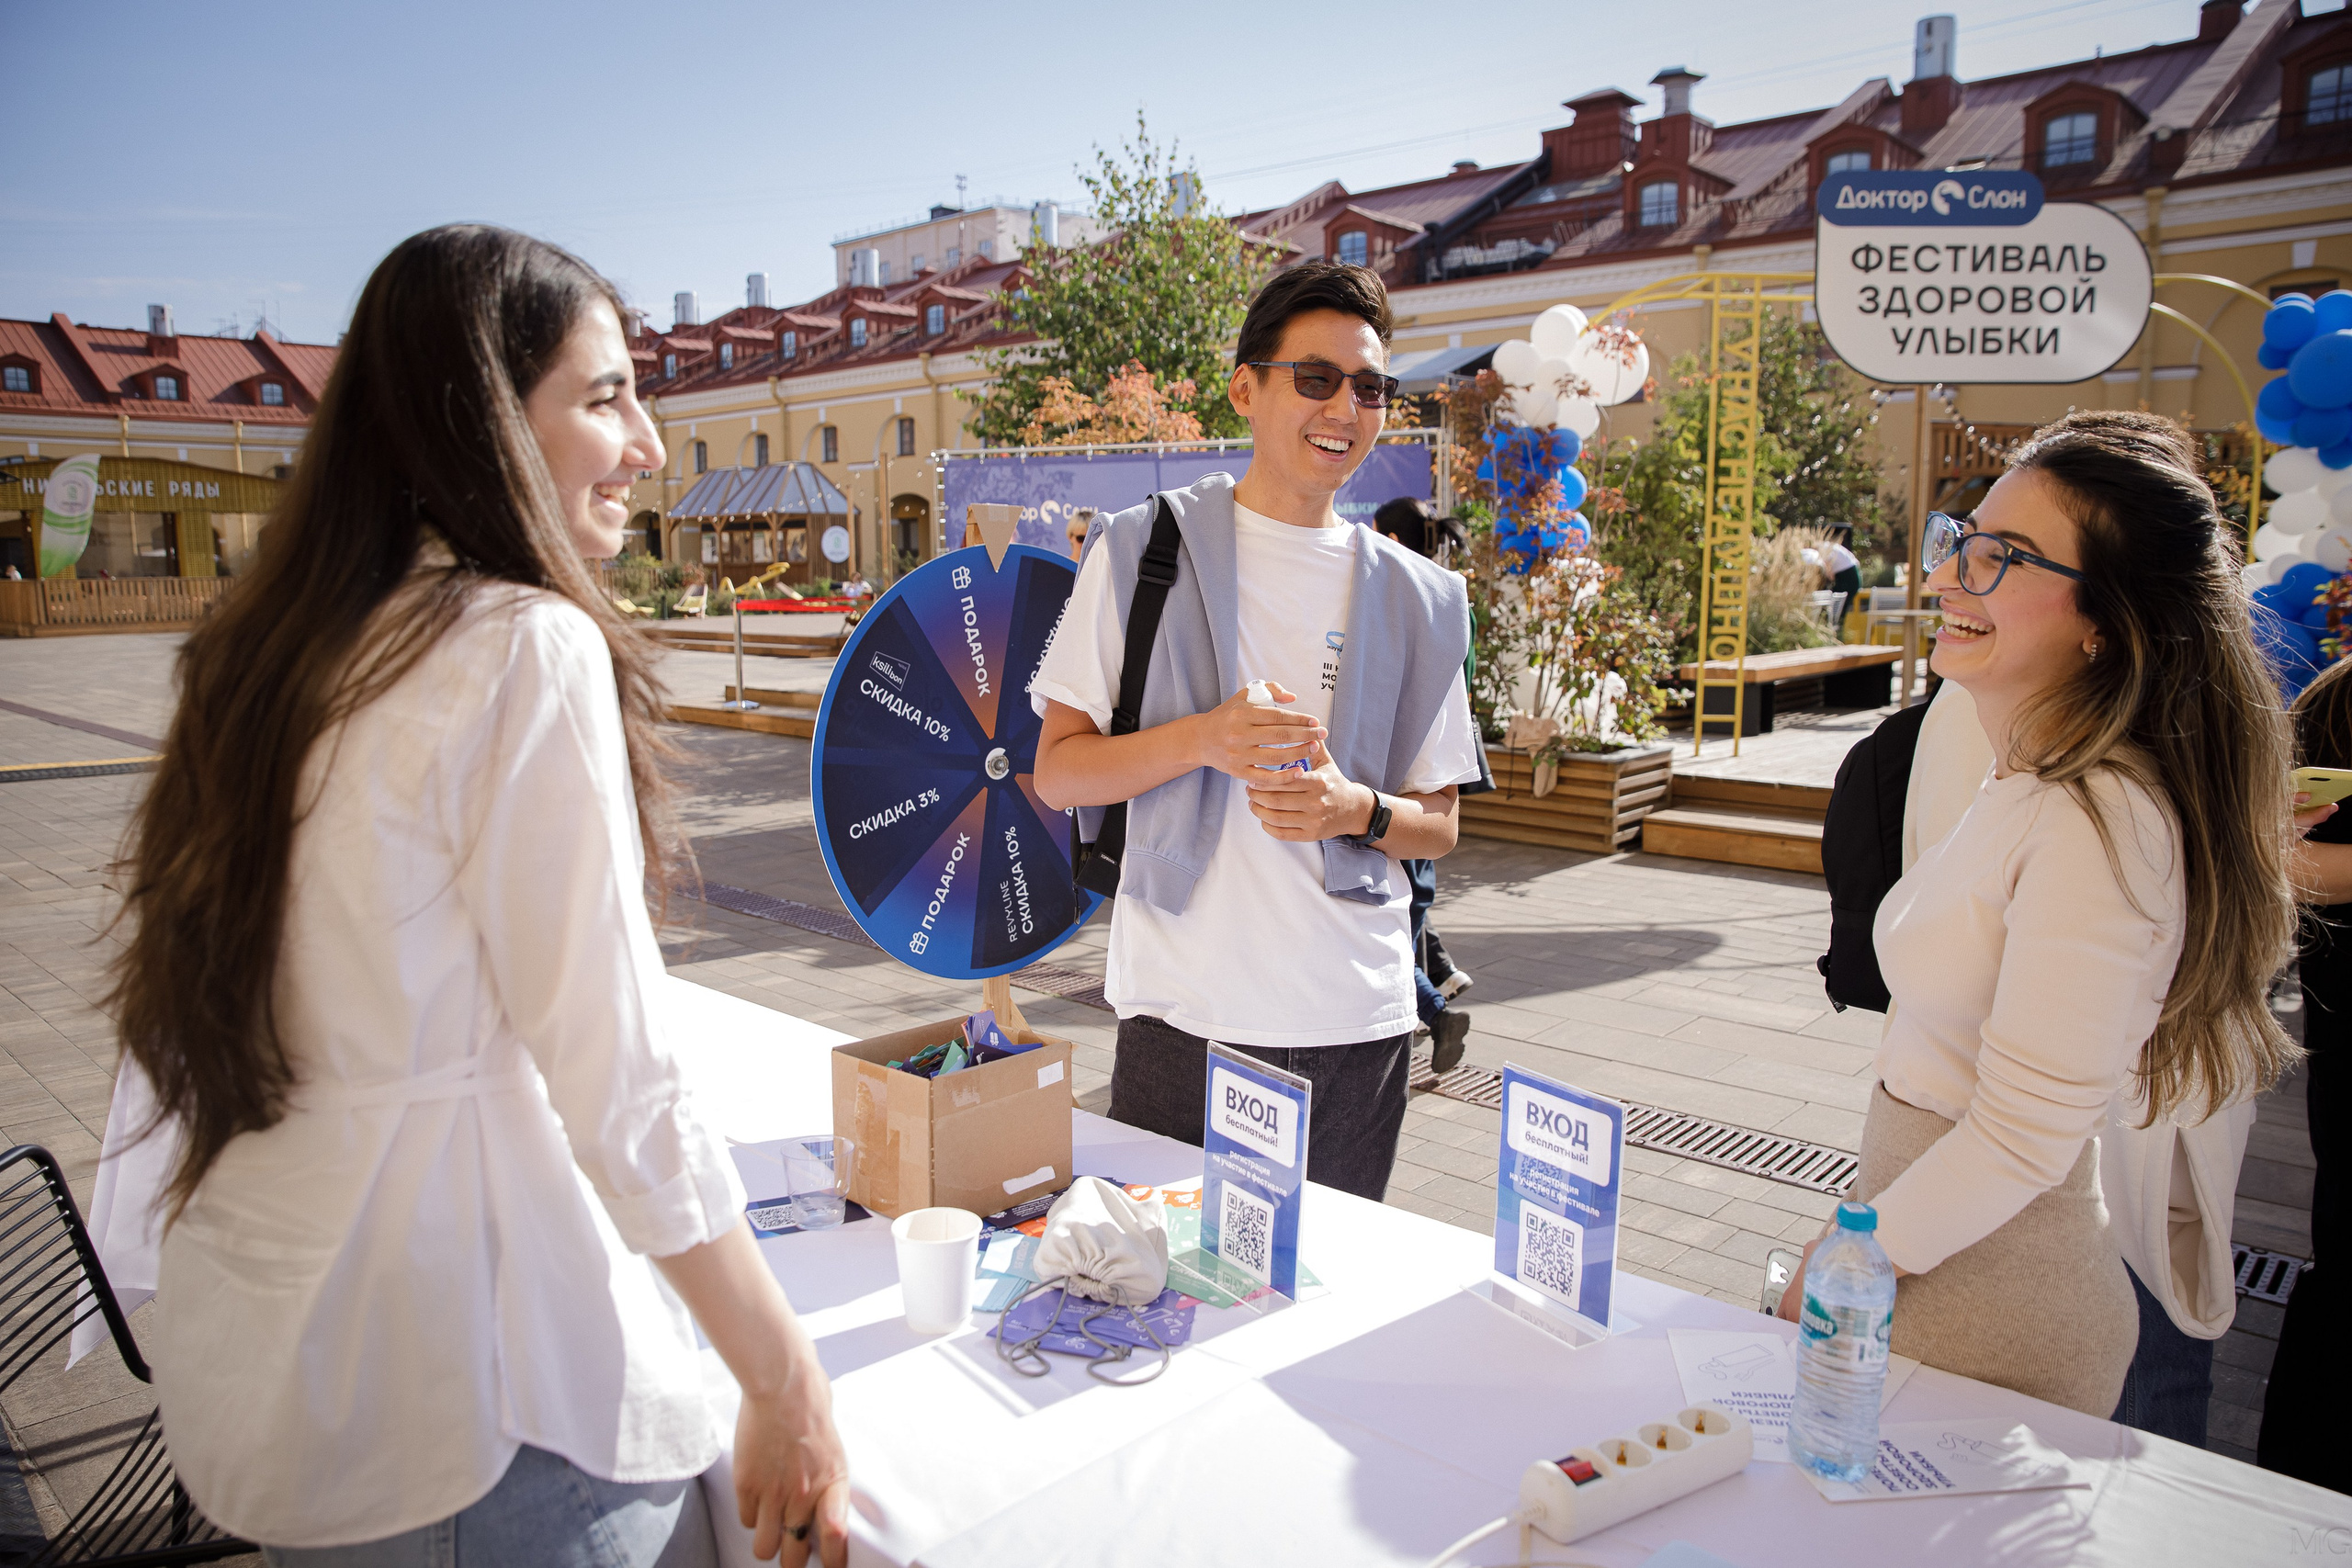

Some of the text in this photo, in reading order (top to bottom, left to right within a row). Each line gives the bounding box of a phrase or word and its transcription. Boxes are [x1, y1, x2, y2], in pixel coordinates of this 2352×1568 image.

[1835, 185, 2027, 213] Доктор Слон
[1851, 243, 2108, 275] ФЕСТИВАЛЬ
[1858, 277, 2097, 320] ЗДОРОВОЙ
[1891, 327, 2062, 356] УЛЫБКИ
[1718, 370, 1752, 448] НАС
[168, 480, 220, 501] РЯДЫ
[960, 595, 991, 698] ПОДАРОК
[860, 678, 952, 742] СКИДКА 10%
[849, 787, 940, 840] СКИДКА 3%
[922, 831, 971, 931] ПОДАРОК
[1004, 826, 1034, 934] СКИДКА 10%
[1000, 880, 1018, 942] REVYLINE
[1226, 1086, 1278, 1134] ВХОД
[1226, 1114, 1278, 1147] бесплатный!
[1526, 1100, 1589, 1151] ВХОД
[1229, 1149, 1272, 1177] регистрация
[1525, 1131, 1589, 1165] бесплатный!
[1213, 1154, 1219, 1162] на
[1221, 1158, 1246, 1178] участие
[1252, 1174, 1288, 1198] фестивале
[1509, 1172, 1519, 1182] на
[1520, 1177, 1550, 1197] участие
[1557, 1191, 1600, 1218] фестивале
[1530, 1168, 1579, 1196] регистрация
[1713, 1397, 1792, 1410] ДОРОВОЙ
[1738, 1408, 1791, 1419] ОВЕТЫ
[1908, 1450, 1957, 1489] УЛЫБКИ
